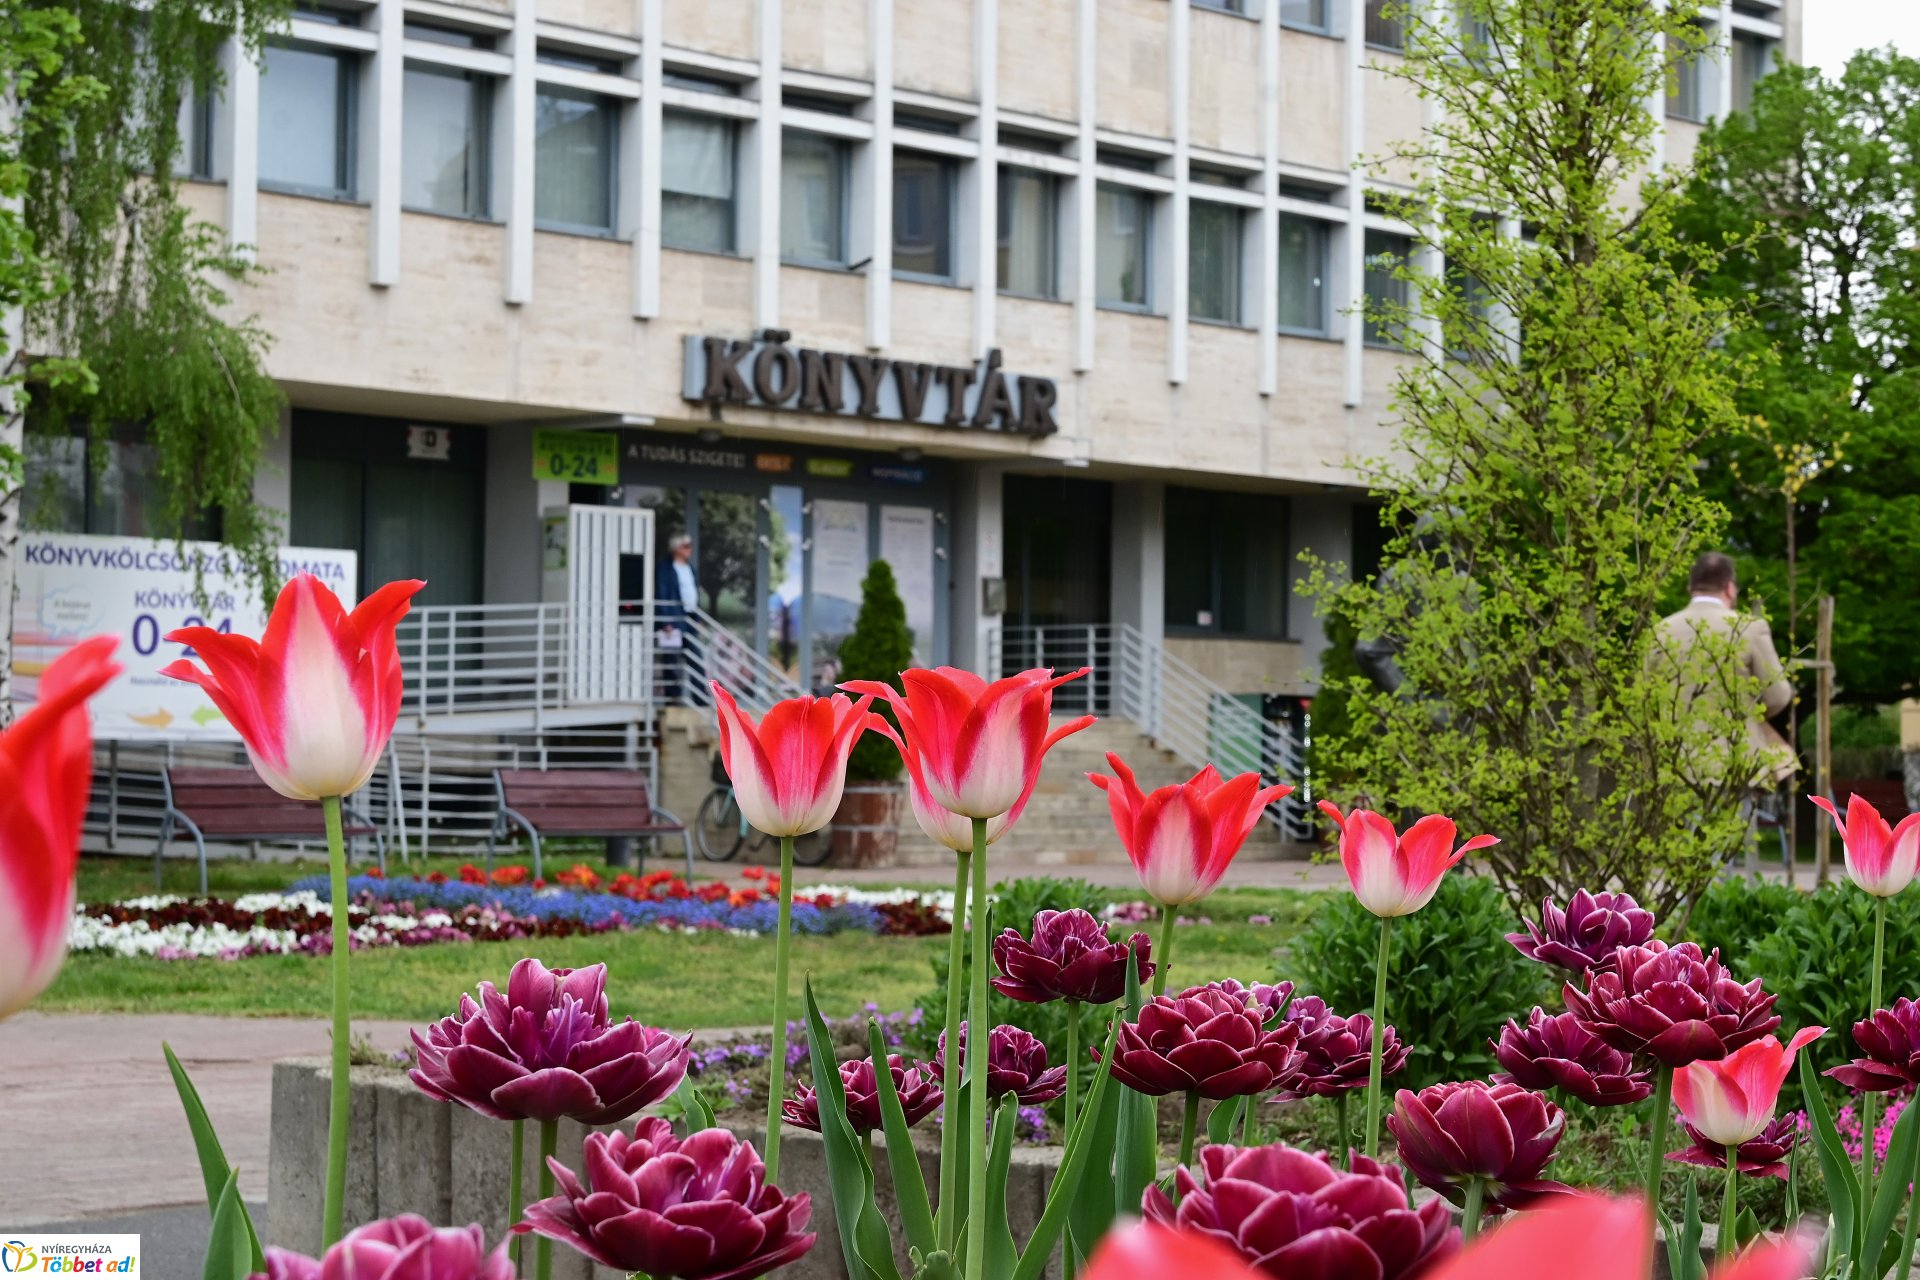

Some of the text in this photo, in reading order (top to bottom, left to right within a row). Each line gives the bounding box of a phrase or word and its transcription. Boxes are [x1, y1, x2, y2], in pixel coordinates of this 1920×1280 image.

[702, 329, 1057, 435] KÖNYVTÁR
[550, 453, 598, 478] 0-24
[627, 443, 638, 459] A
[641, 444, 686, 464] TUDÁS
